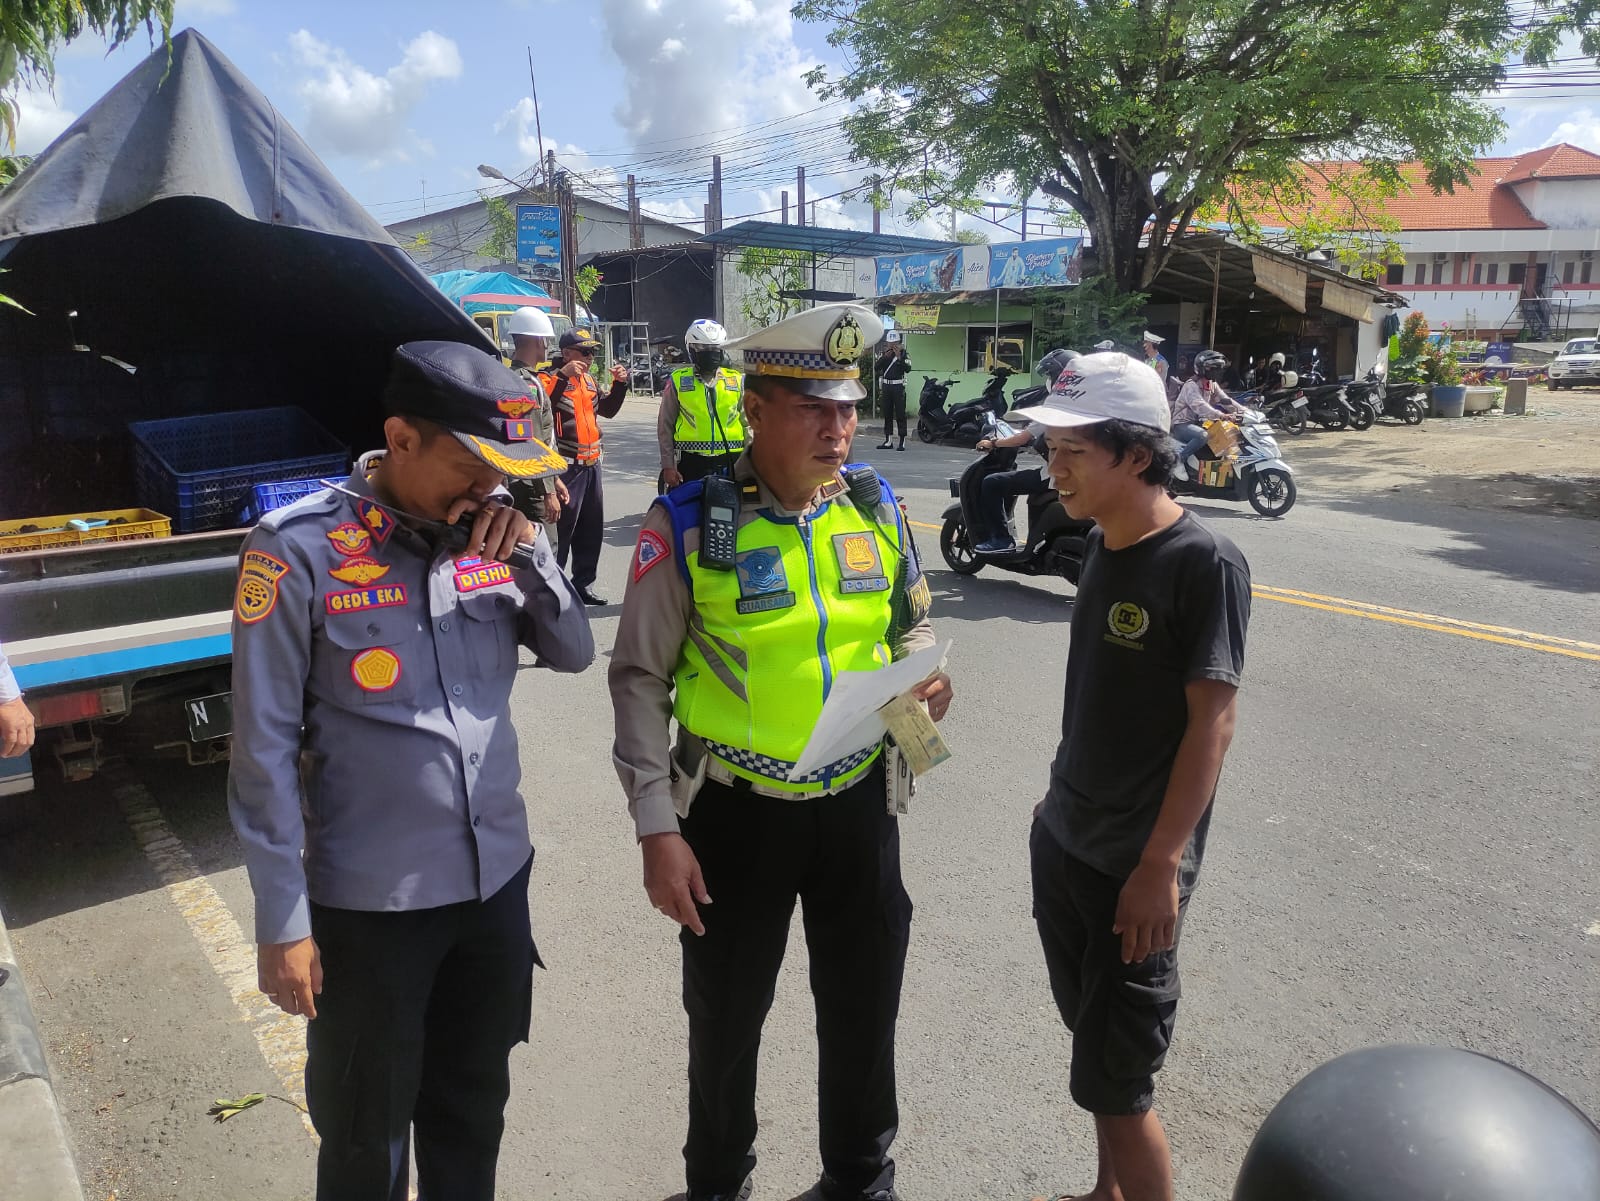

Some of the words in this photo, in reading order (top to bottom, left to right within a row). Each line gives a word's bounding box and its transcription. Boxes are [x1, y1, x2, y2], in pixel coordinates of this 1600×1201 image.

[460, 565, 511, 587] DISHU
[846, 580, 886, 591] POLRI
[331, 591, 370, 610] GEDE
[376, 587, 404, 604] EKA
[190, 700, 209, 726] N
